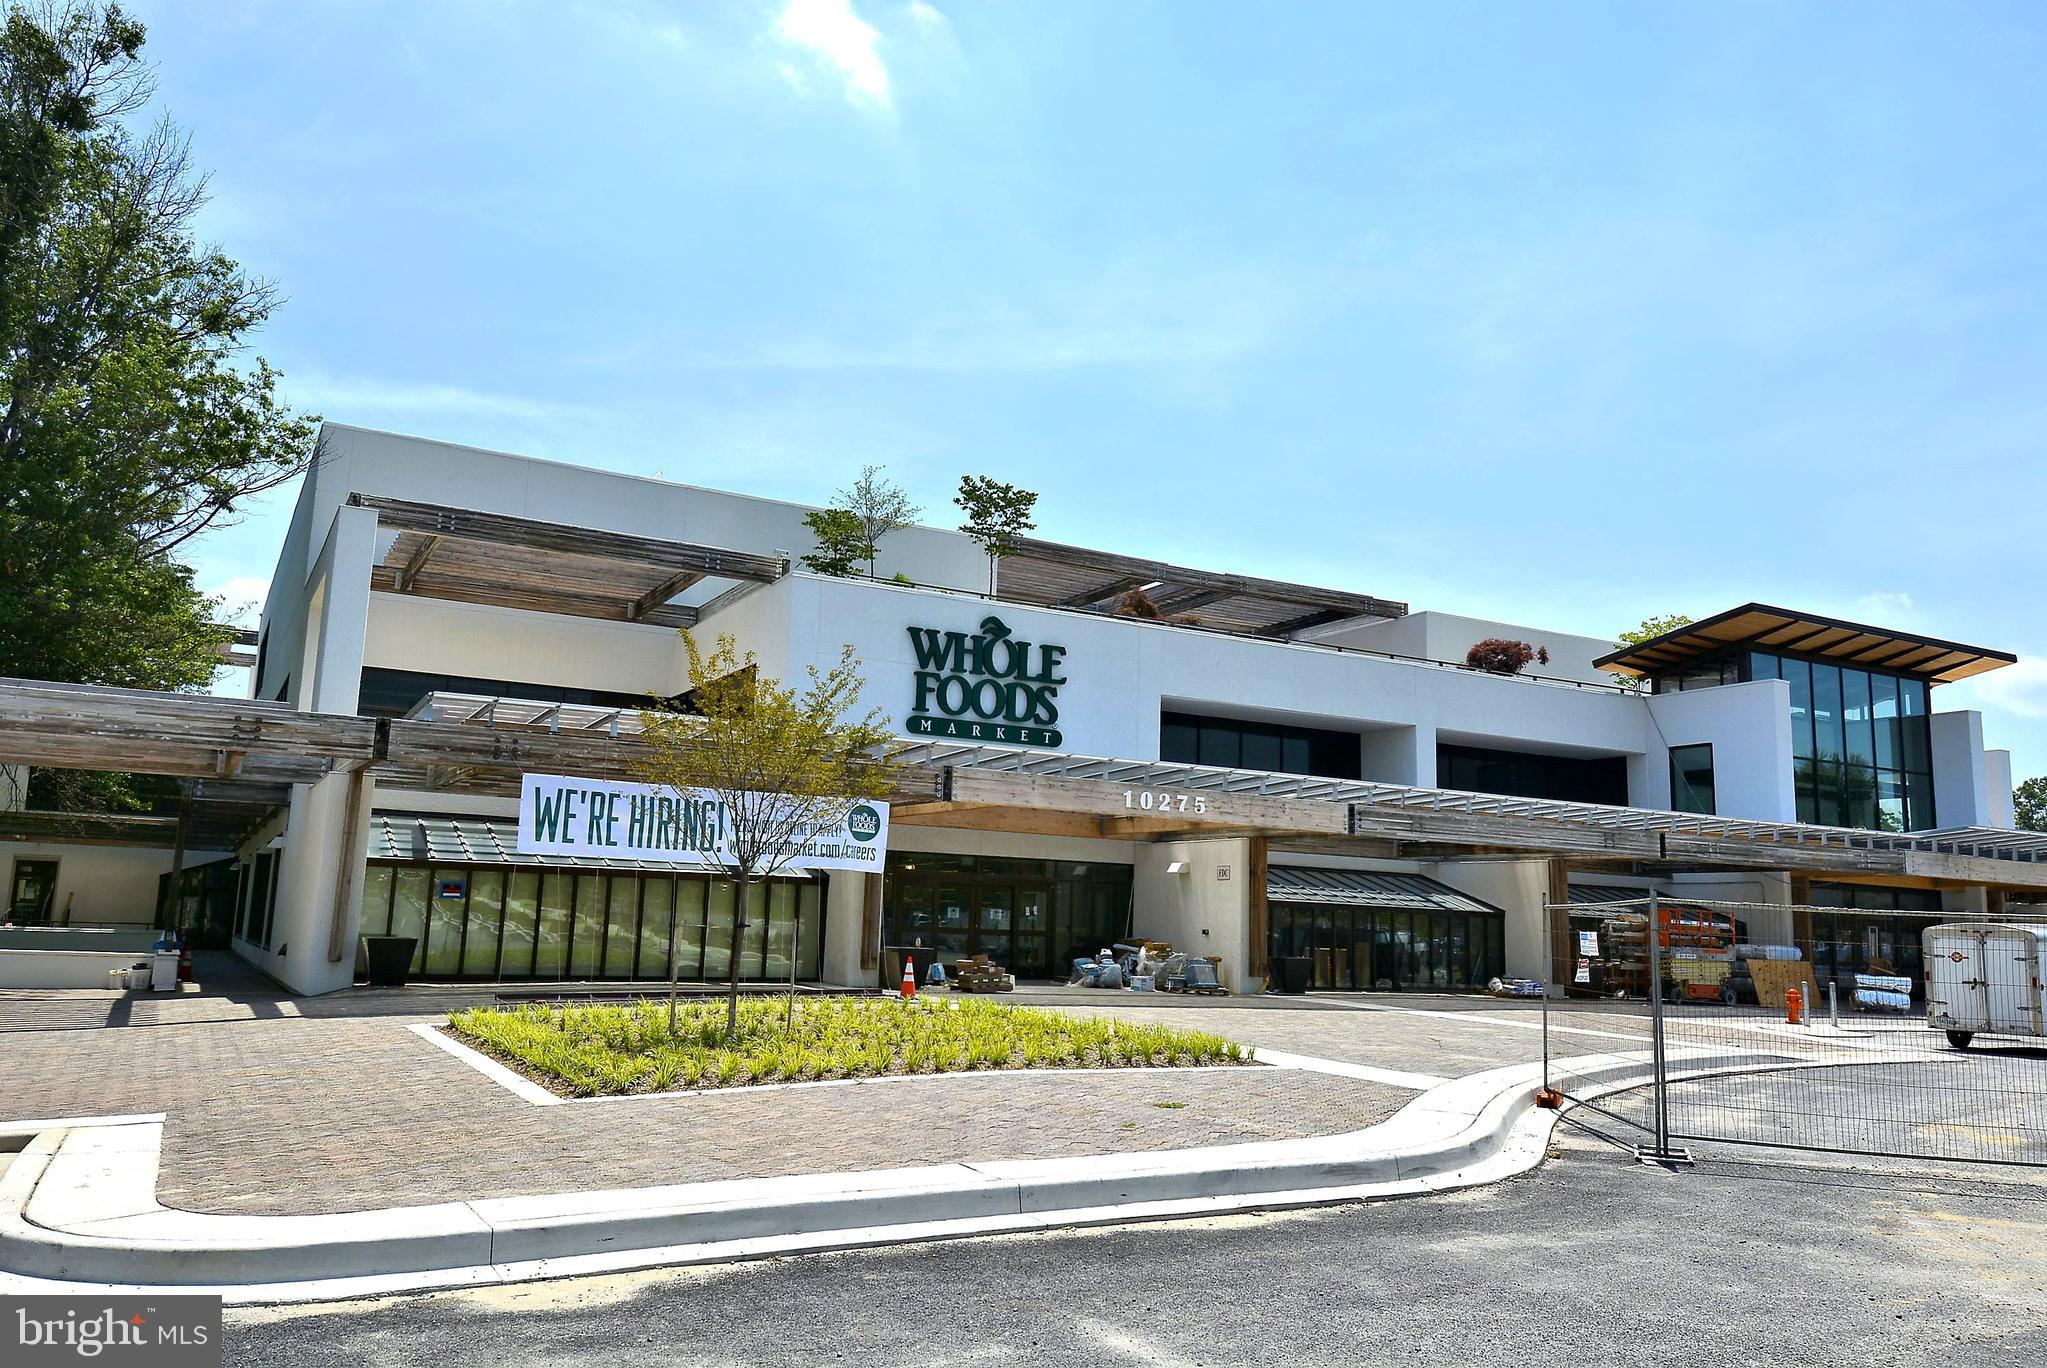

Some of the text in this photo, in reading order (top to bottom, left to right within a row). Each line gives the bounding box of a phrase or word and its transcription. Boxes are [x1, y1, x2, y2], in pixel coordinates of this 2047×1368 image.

[906, 621, 1067, 685] WHOLE
[912, 671, 1059, 725] FOODS
[920, 719, 1052, 744] MARKET
[1123, 790, 1206, 814] 10275
[534, 786, 725, 853] WE'RE HIRING!
[851, 813, 877, 824] WHOLE
[852, 821, 875, 831] FOODS
